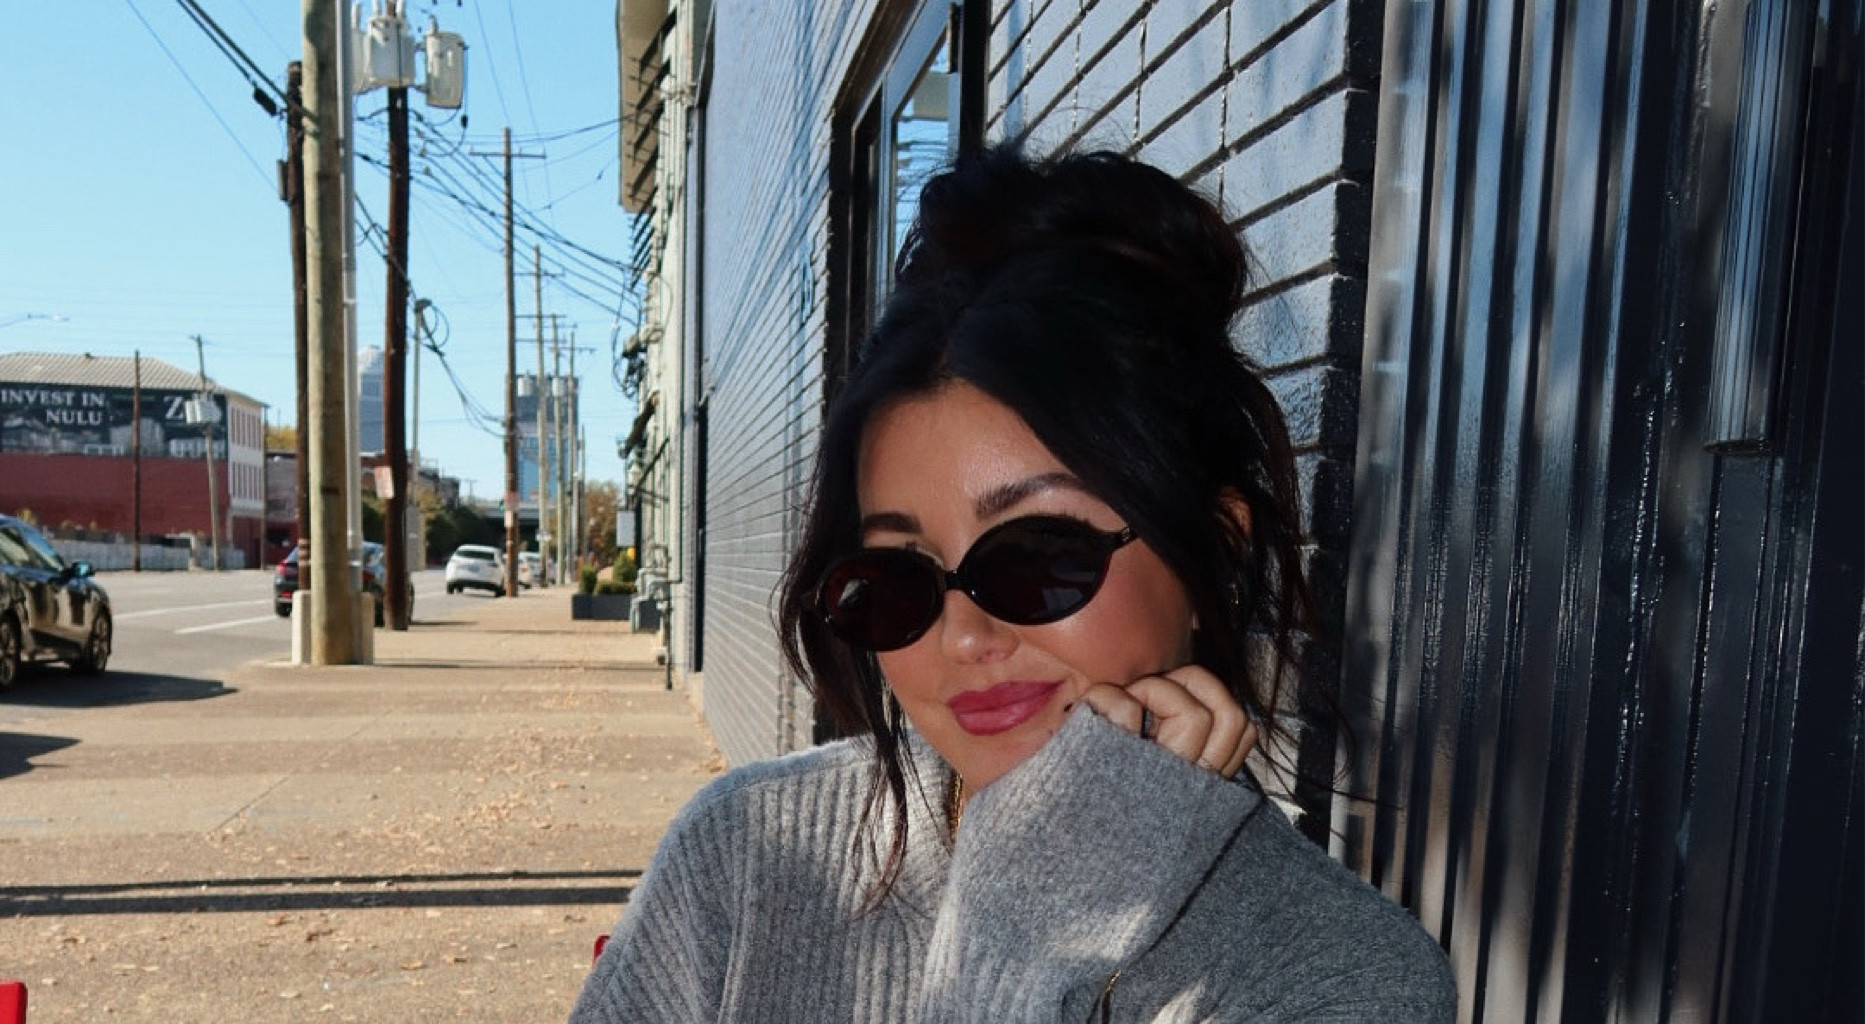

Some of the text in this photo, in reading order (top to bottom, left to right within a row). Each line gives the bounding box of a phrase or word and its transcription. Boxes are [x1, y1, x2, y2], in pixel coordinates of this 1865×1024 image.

[1, 388, 106, 408] INVEST IN
[46, 408, 103, 426] NULU
